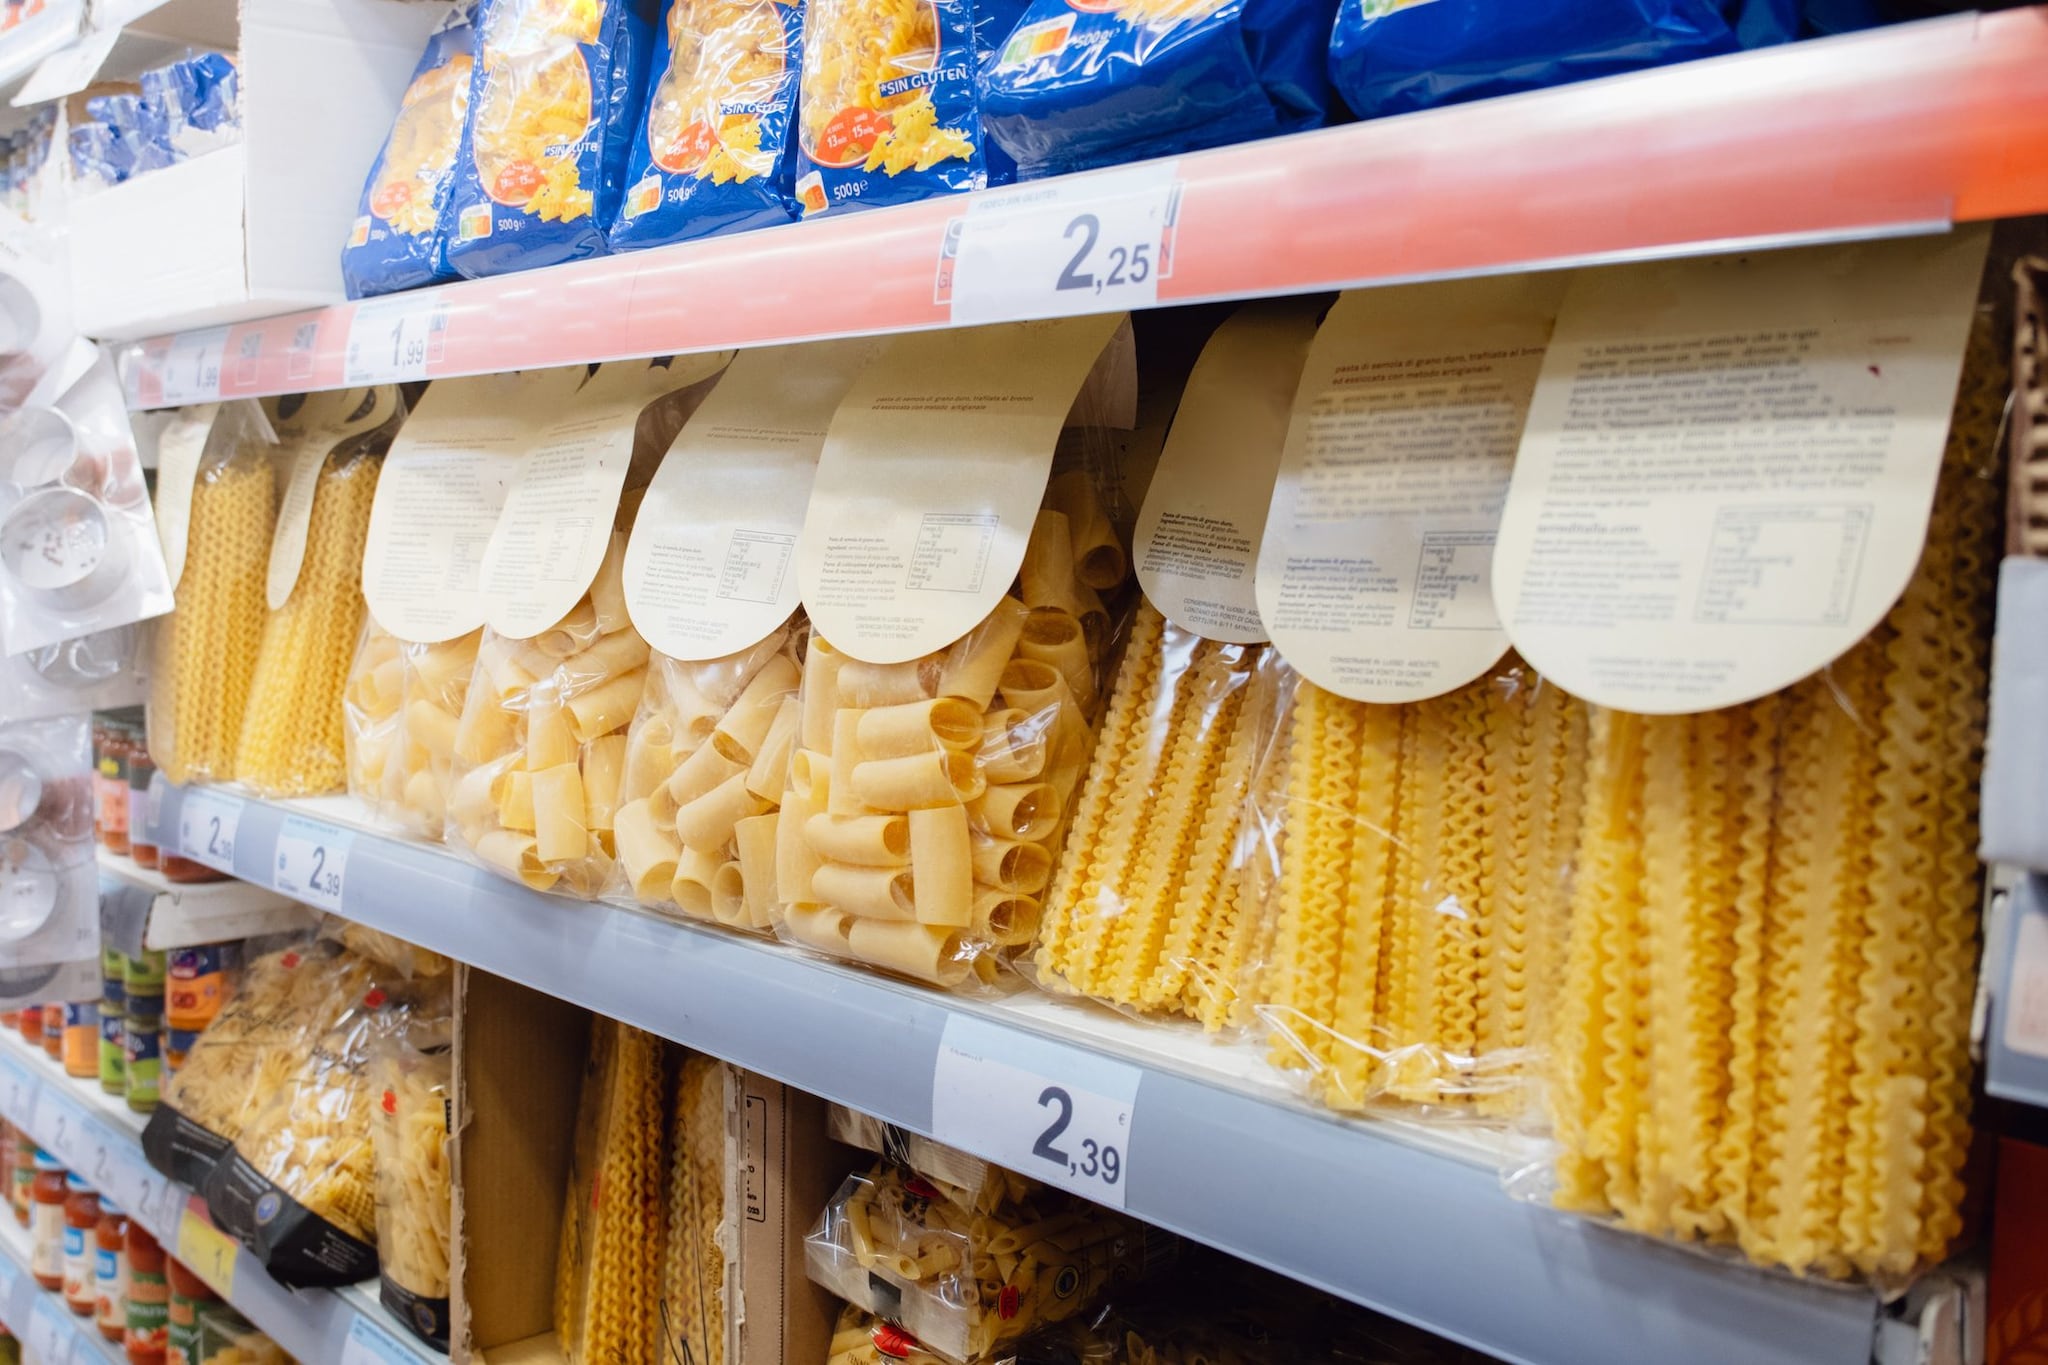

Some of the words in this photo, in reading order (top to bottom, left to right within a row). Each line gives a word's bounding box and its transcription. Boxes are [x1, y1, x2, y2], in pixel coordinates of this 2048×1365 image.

[911, 66, 967, 89] GLUTEN
[833, 181, 861, 201] 500g
[498, 218, 520, 232] 500g
[1056, 213, 1151, 295] 2,25
[391, 317, 425, 368] 1,99
[315, 847, 348, 901] 2,39
[1032, 1086, 1121, 1185] 2,39
